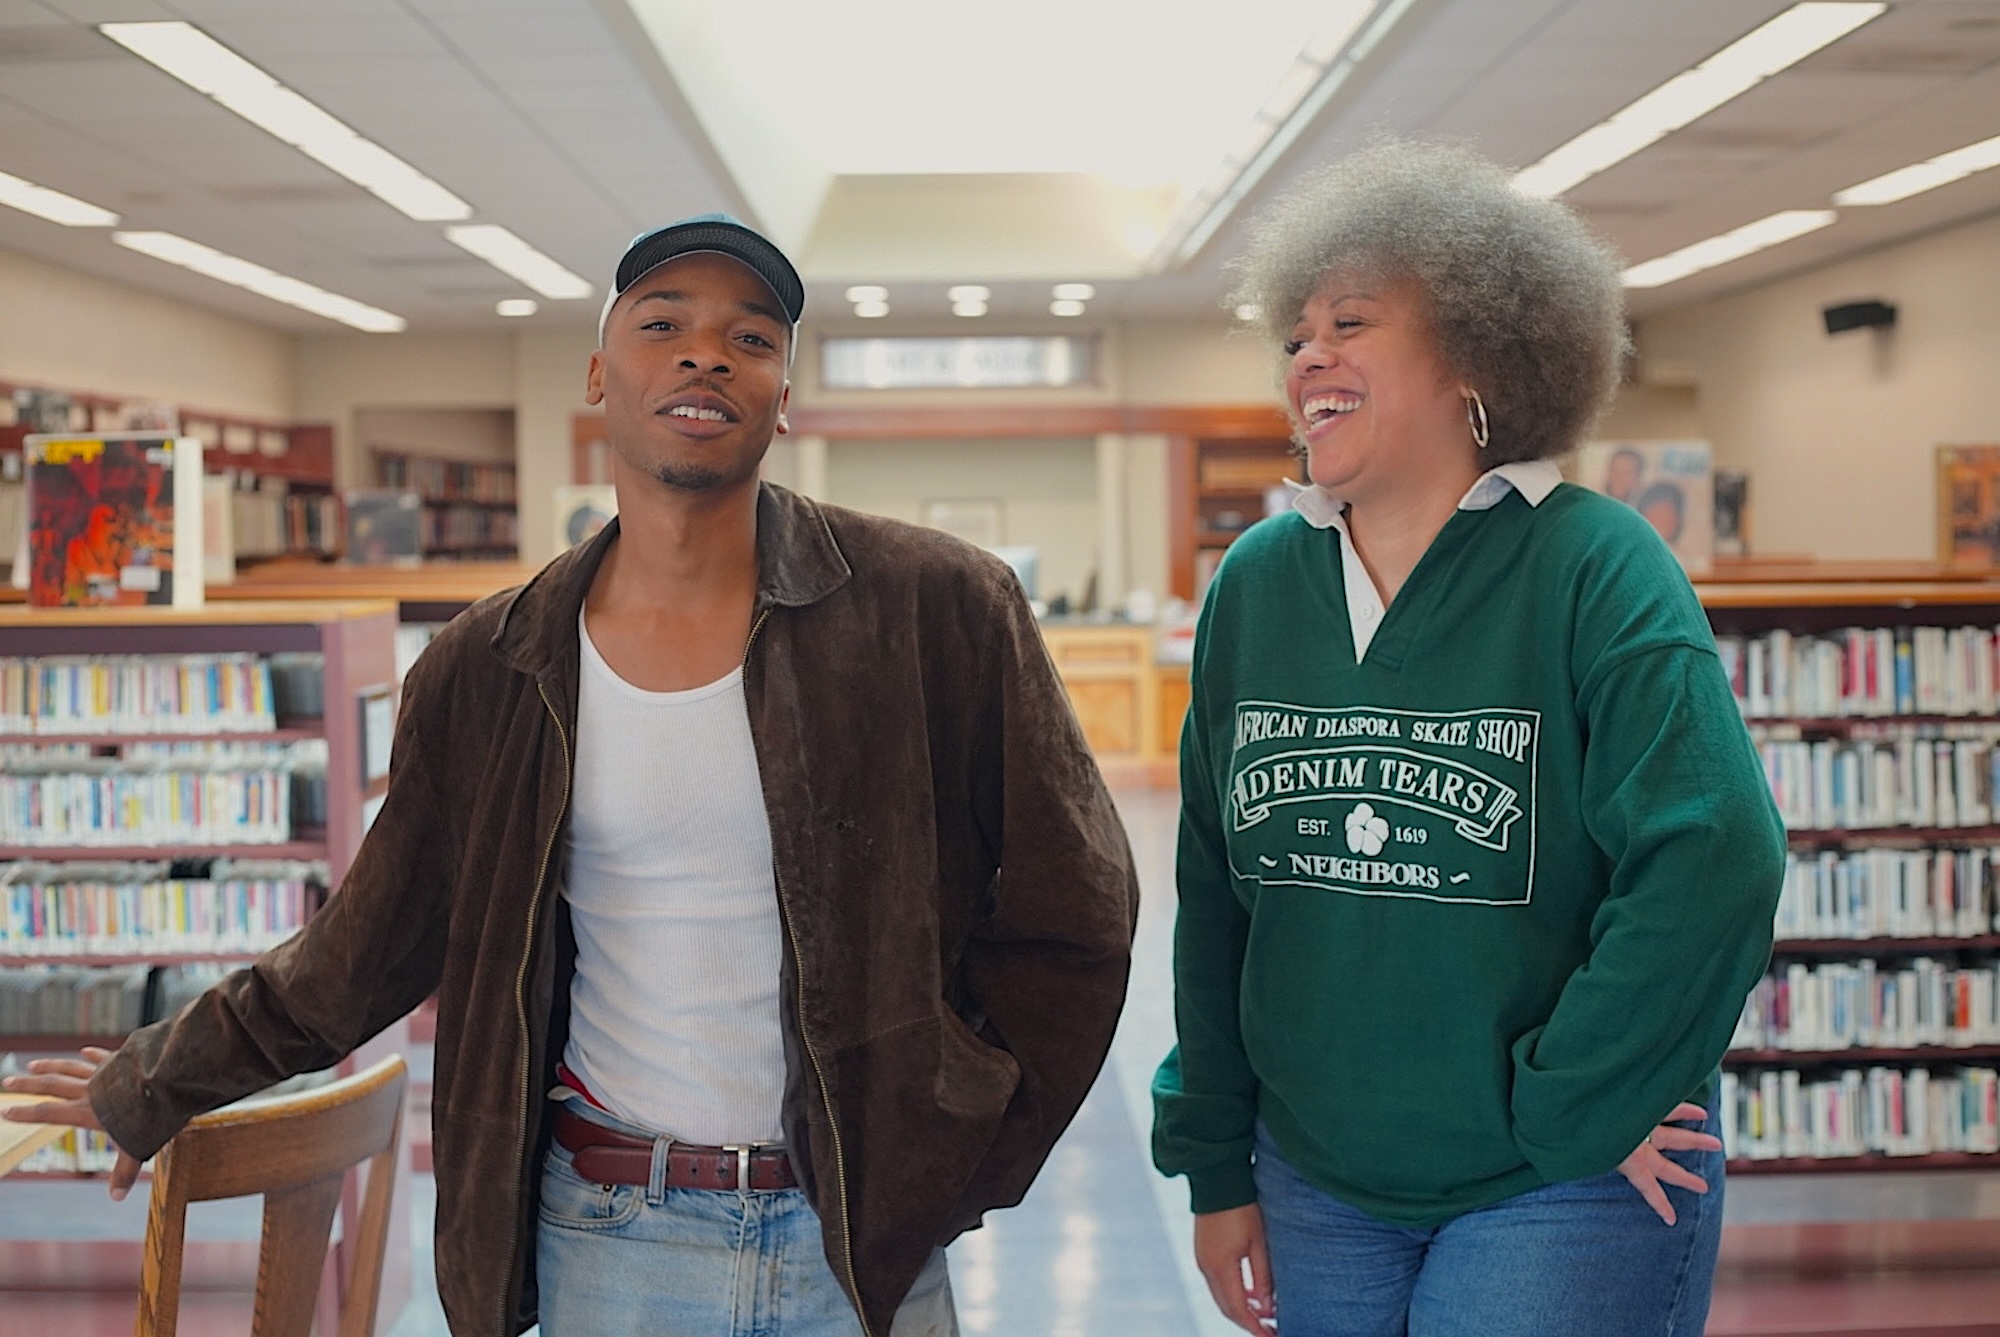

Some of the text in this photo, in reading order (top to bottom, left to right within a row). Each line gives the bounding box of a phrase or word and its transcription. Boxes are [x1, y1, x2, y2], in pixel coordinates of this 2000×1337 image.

[1314, 717, 1401, 738] DIASPORA
[1411, 720, 1471, 745] SKATE
[1476, 718, 1531, 763] SHOP
[1247, 757, 1489, 814] DENIM TEARS
[1297, 818, 1427, 845] EST. 1619
[1288, 853, 1440, 889] NEIGHBORS
